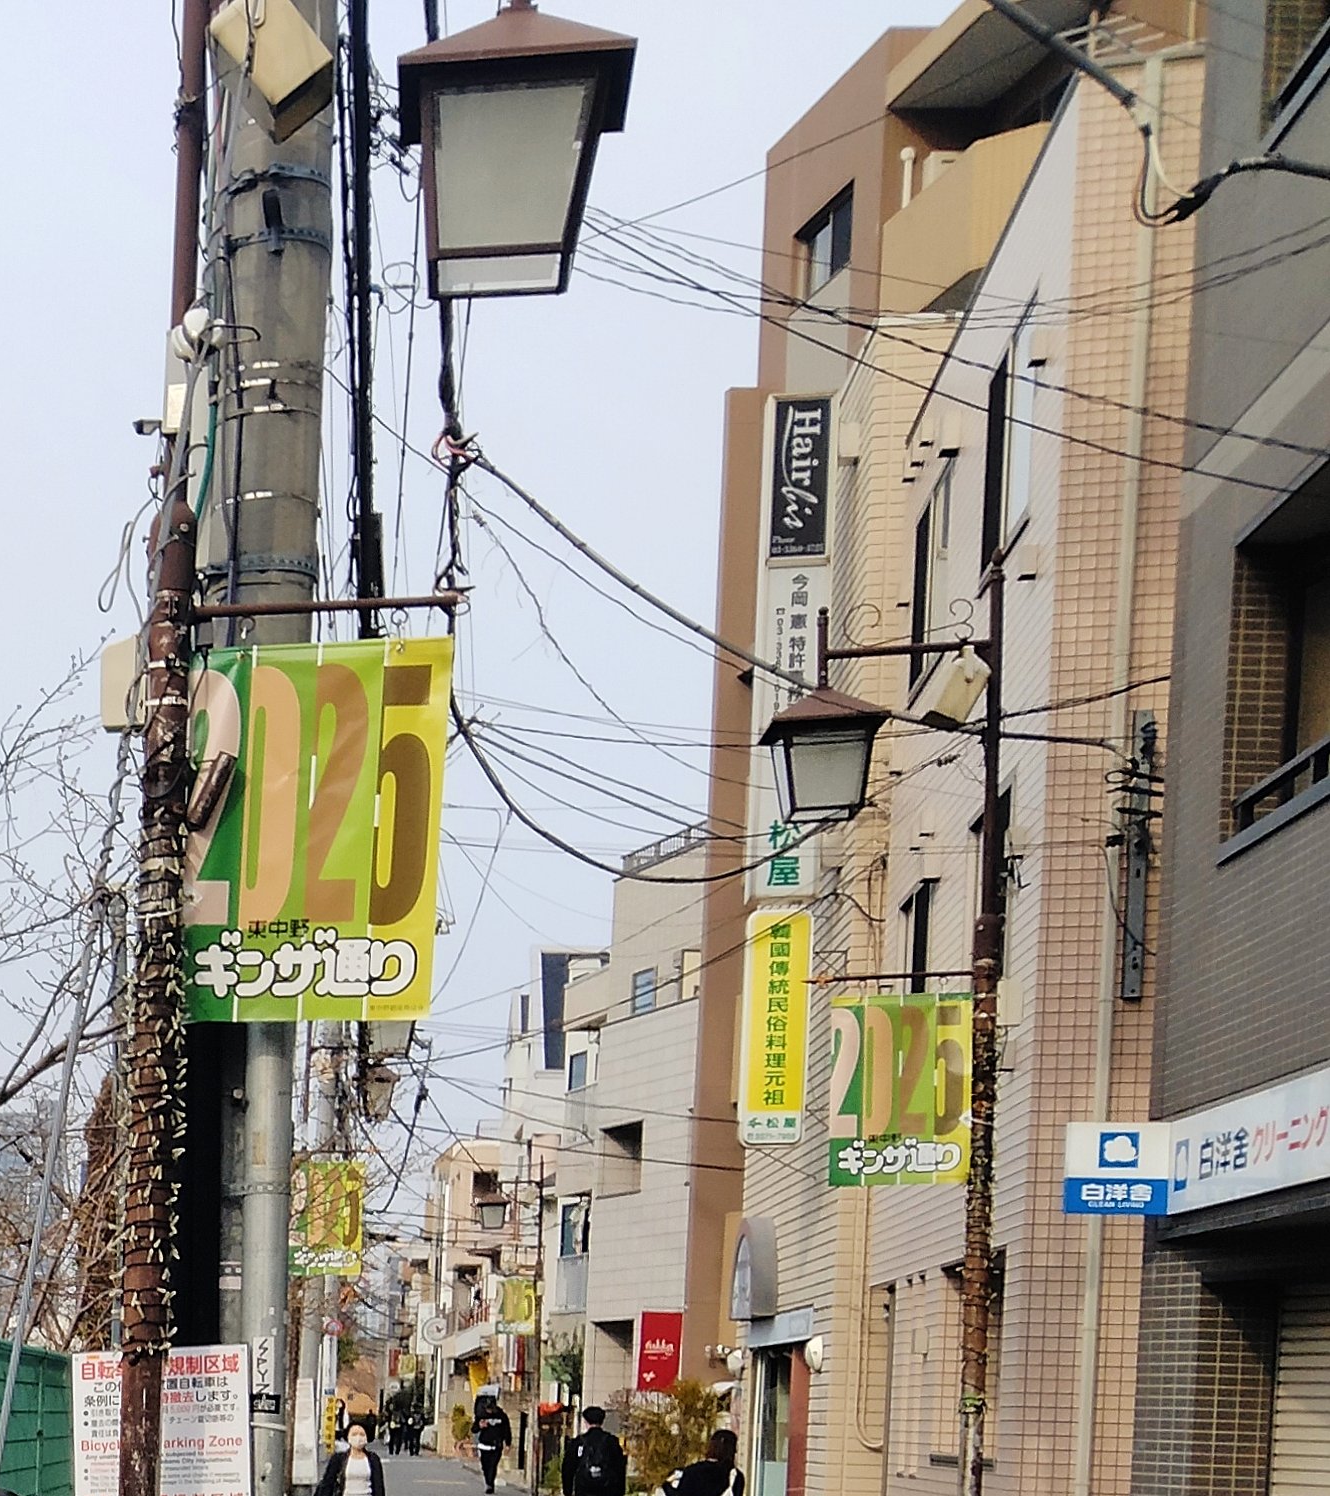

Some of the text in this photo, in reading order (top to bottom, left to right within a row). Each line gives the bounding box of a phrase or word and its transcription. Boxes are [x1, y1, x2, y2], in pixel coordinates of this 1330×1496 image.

[791, 408, 822, 487] Hair
[182, 662, 432, 926] 2025
[766, 818, 803, 887] 松屋
[192, 926, 417, 998] ギンザ通り
[246, 917, 310, 940] 東中野
[829, 1004, 965, 1138] 2025
[838, 1137, 962, 1175] ギンザ通り
[208, 1435, 244, 1448] Zone
